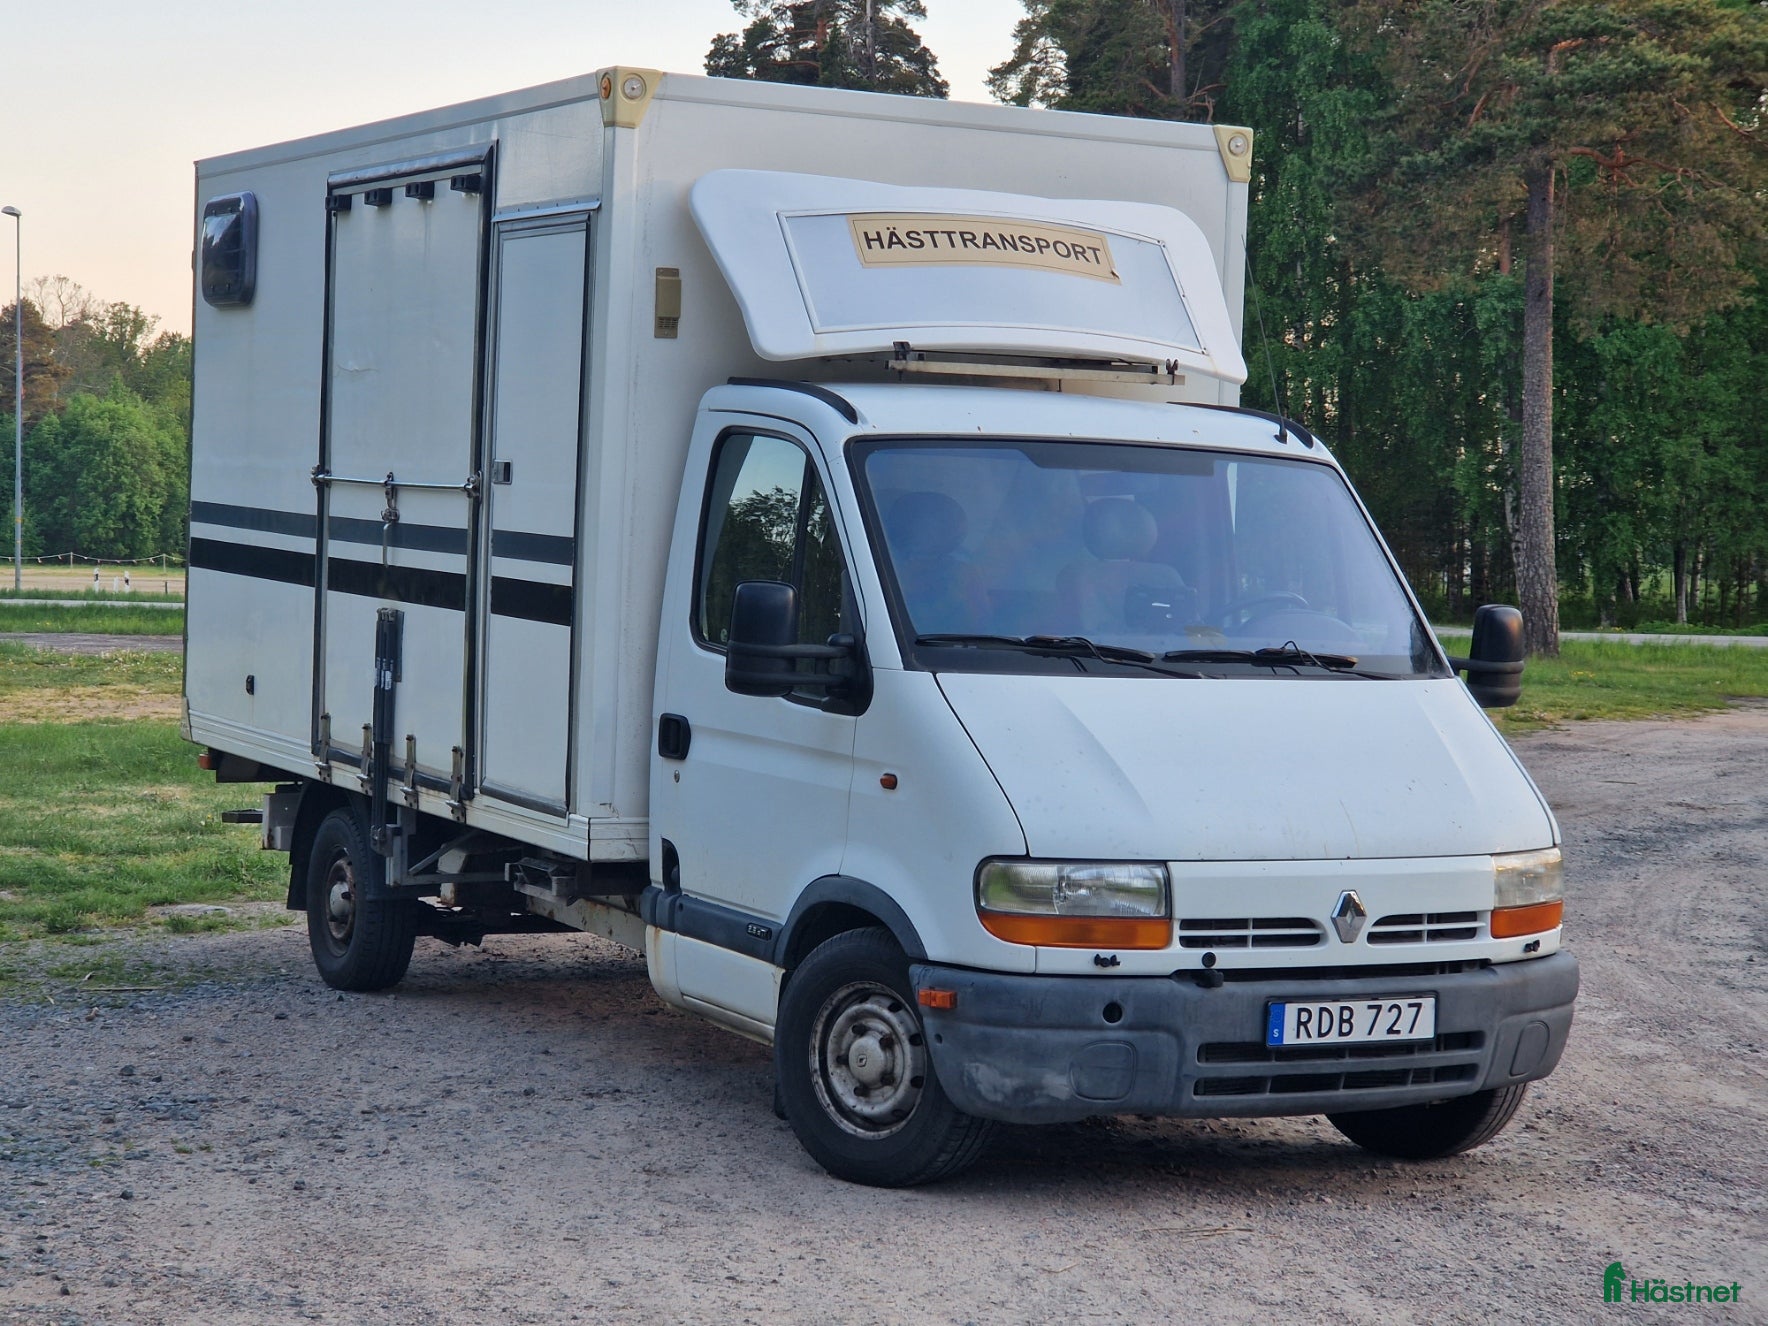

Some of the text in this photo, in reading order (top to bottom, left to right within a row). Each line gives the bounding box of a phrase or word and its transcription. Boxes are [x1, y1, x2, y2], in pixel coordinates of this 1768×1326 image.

[863, 227, 1100, 265] HÄSTTRANSPORT
[1272, 1003, 1423, 1039] S RDB 727
